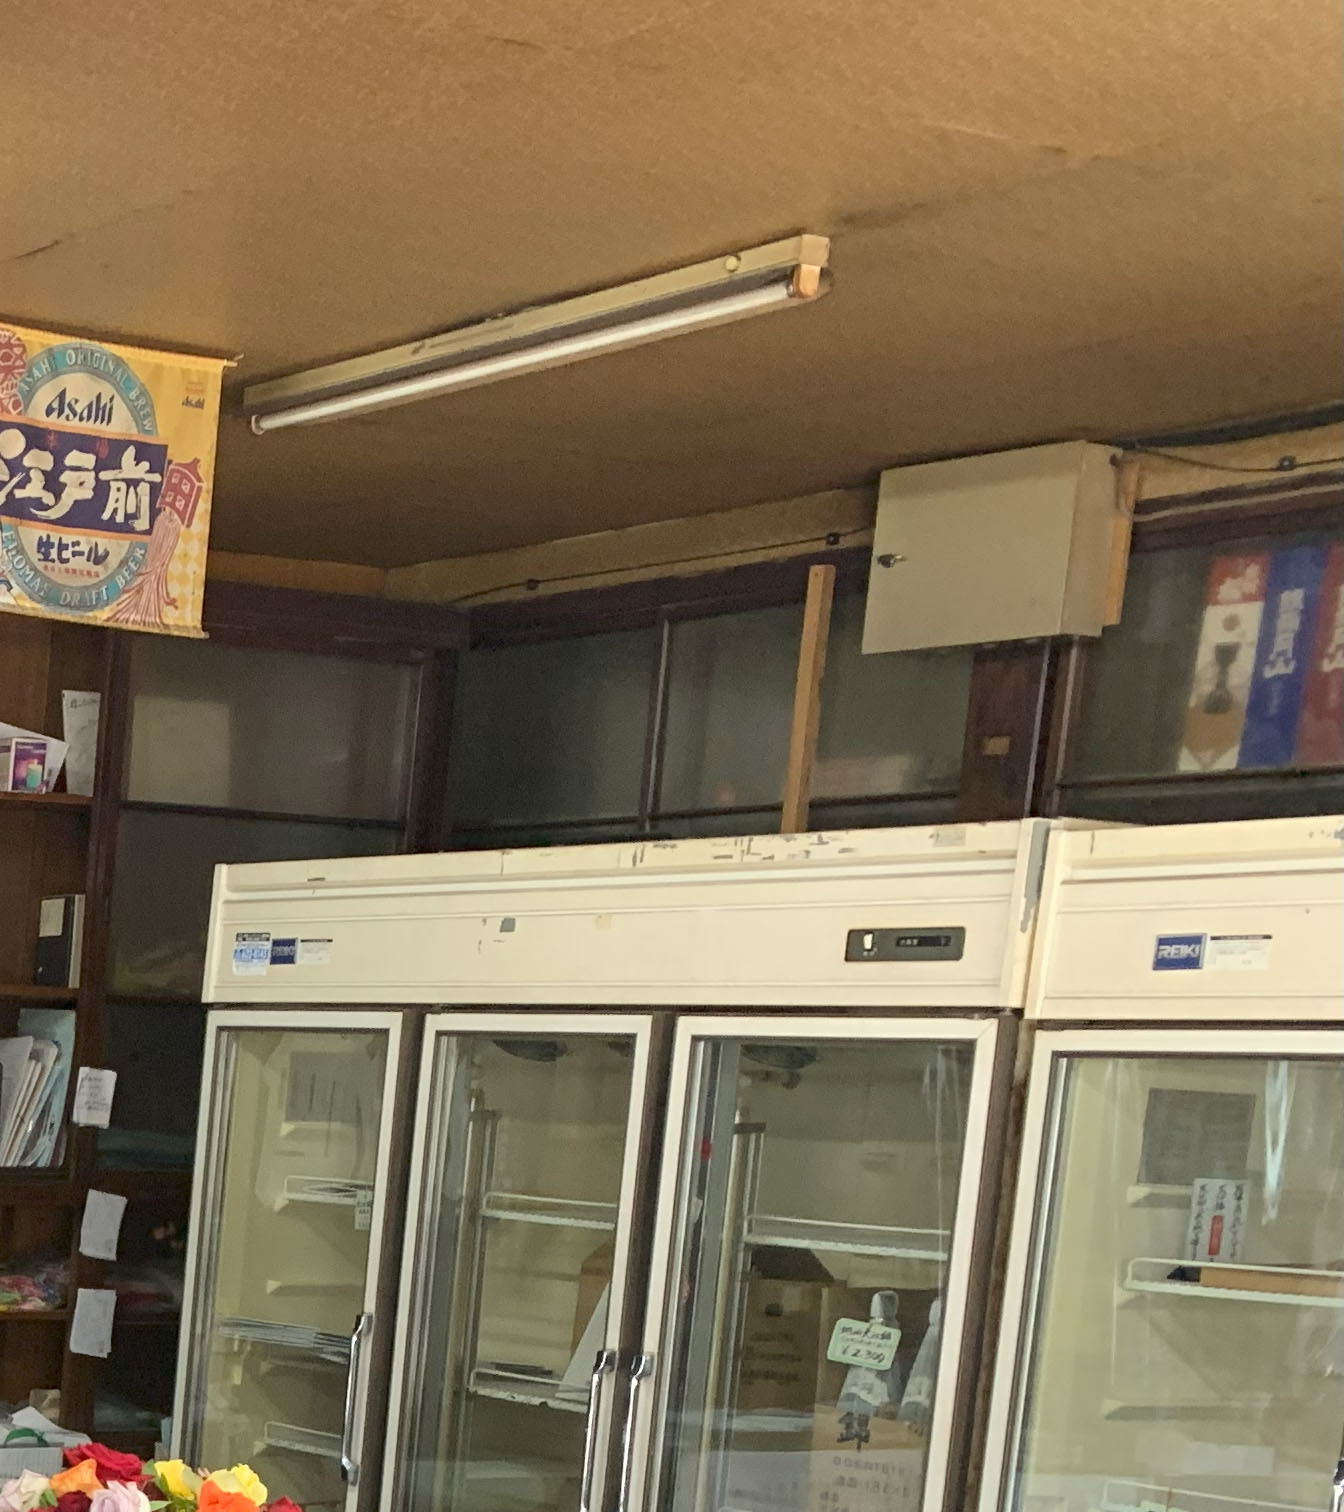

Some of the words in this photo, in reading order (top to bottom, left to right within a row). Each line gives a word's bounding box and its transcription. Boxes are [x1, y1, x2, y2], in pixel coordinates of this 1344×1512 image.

[45, 387, 115, 427] Asahi
[36, 533, 111, 566] 生ビール
